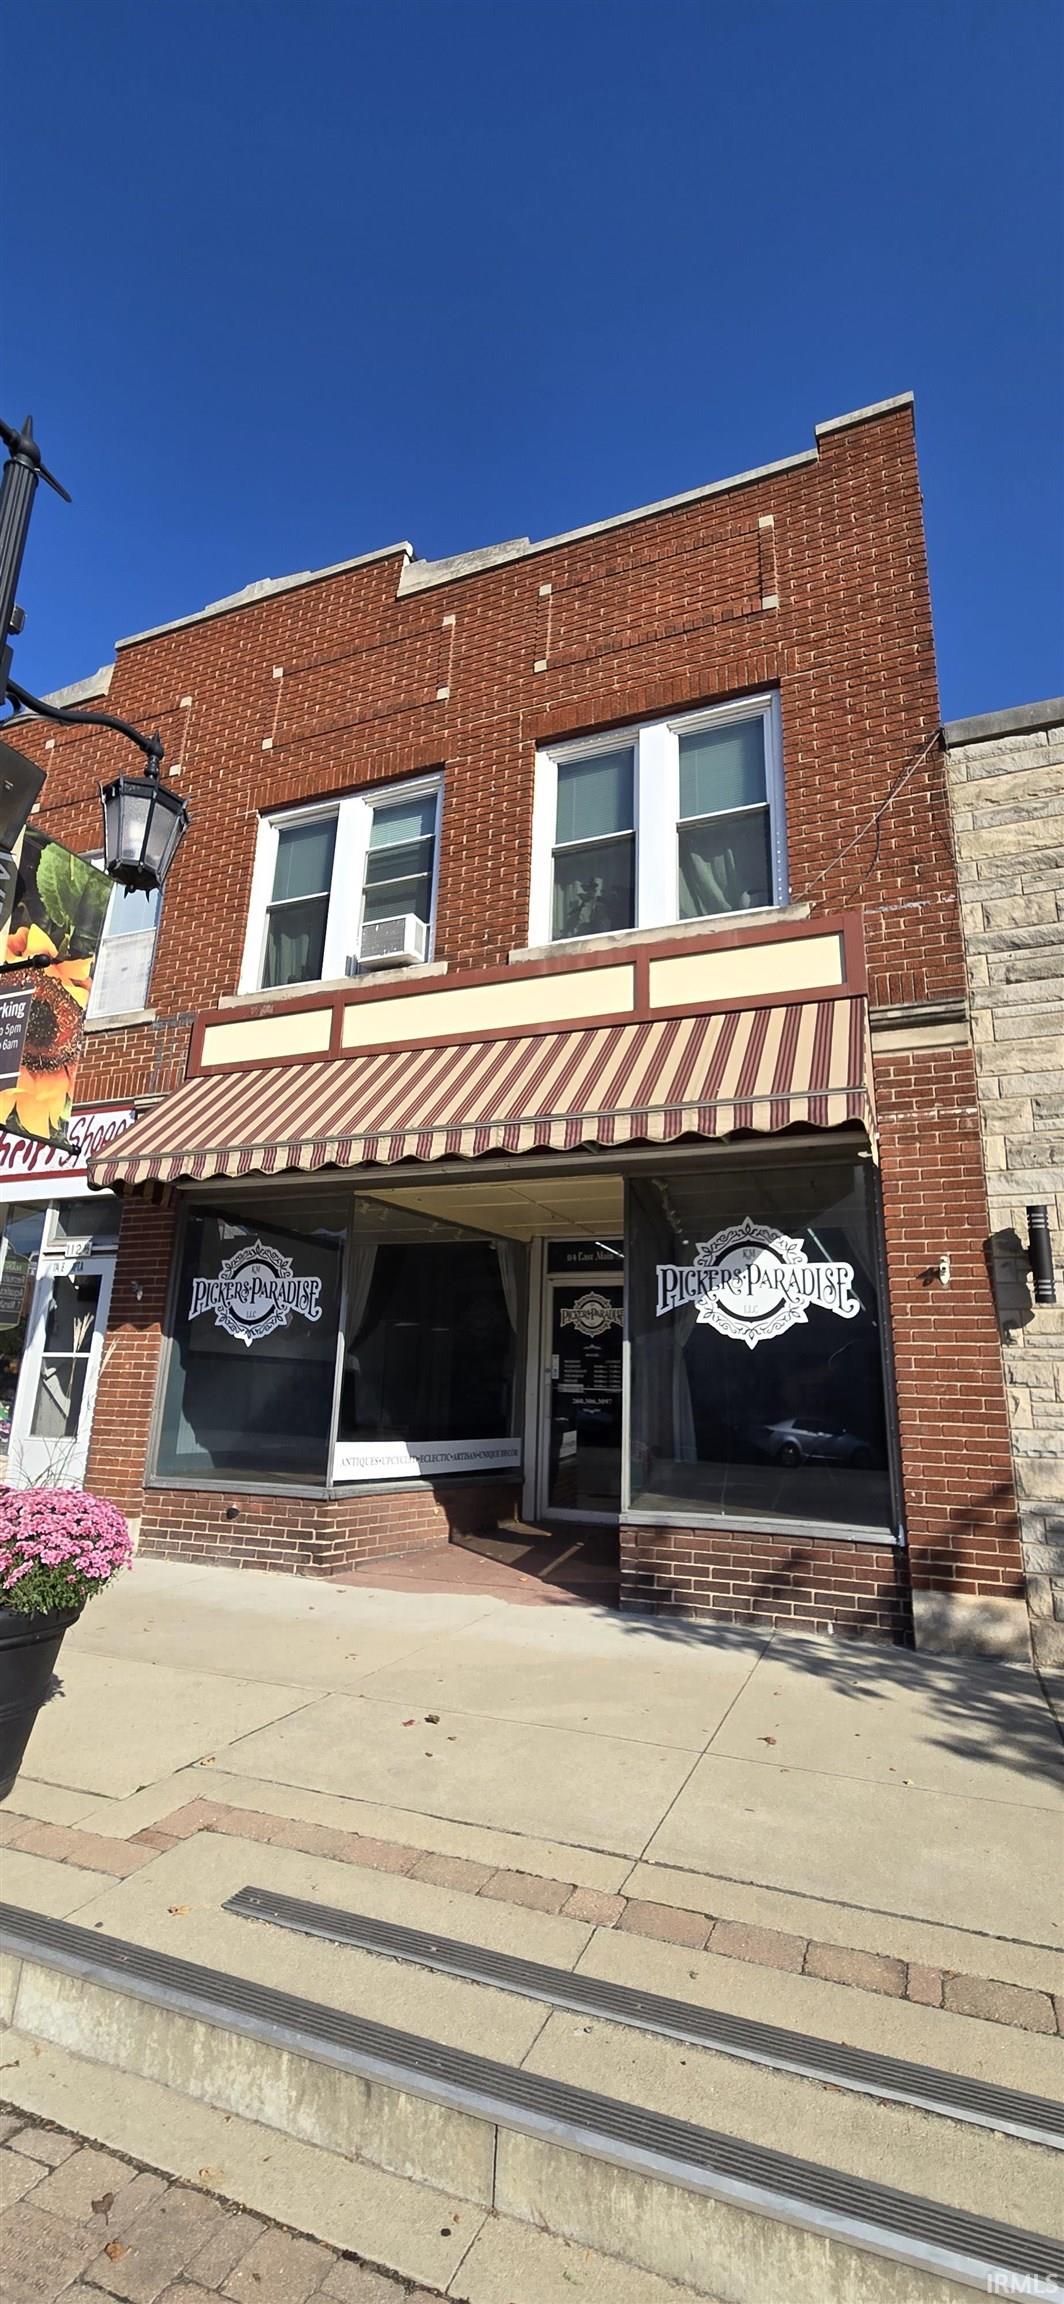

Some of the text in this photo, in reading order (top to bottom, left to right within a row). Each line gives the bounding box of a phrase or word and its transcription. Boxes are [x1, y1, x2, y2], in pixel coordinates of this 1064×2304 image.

[5, 1024, 22, 1036] 5pm
[2, 1039, 19, 1051] 6am
[746, 1263, 855, 1314] PARADISE
[250, 1277, 321, 1318] PARADISE
[743, 1304, 759, 1314] LLC
